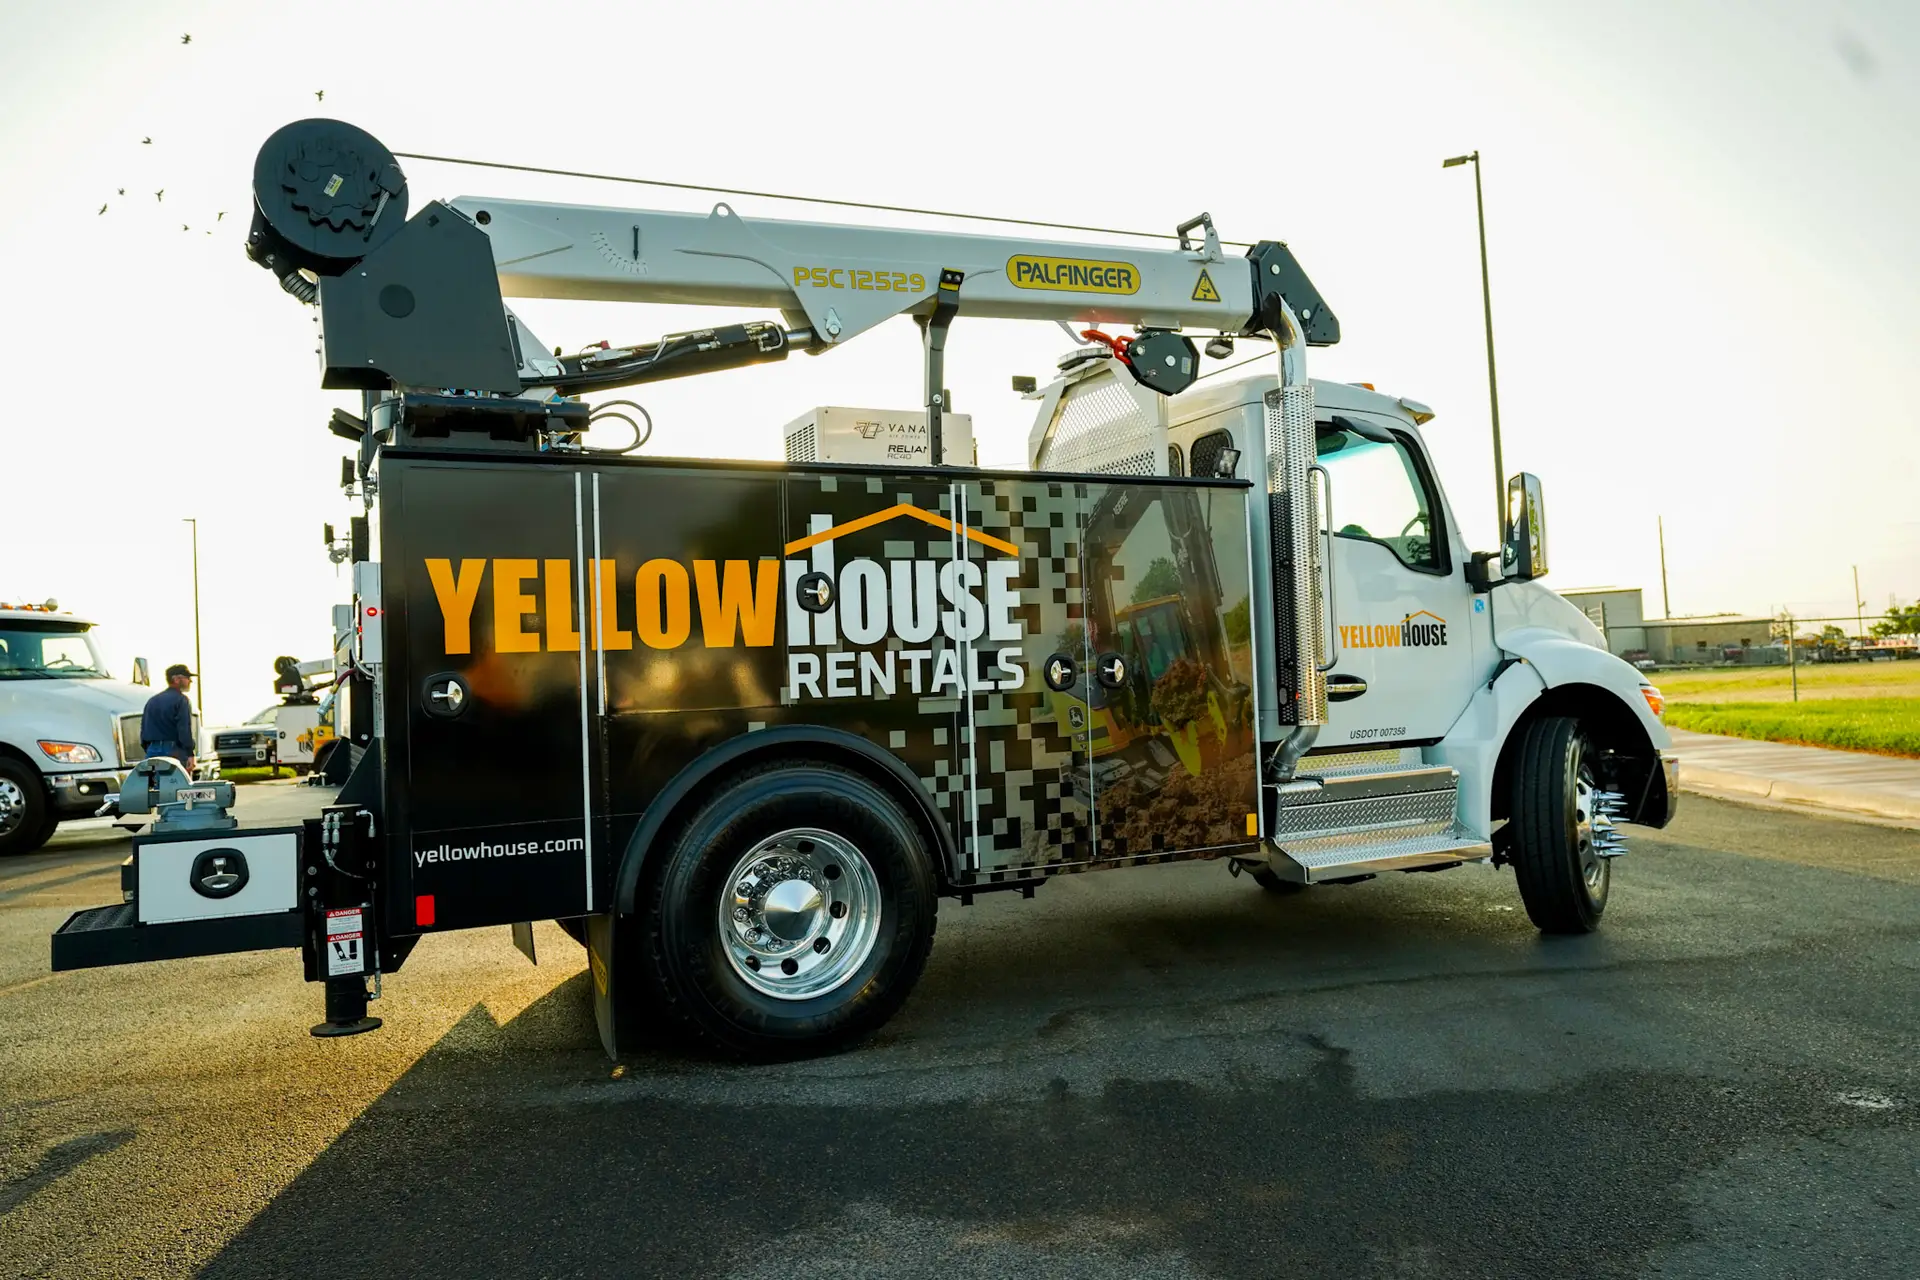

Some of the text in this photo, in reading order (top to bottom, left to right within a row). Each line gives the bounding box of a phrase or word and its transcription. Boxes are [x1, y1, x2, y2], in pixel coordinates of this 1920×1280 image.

[793, 266, 926, 293] PSC 12529
[1016, 261, 1133, 289] PALFINGER
[888, 423, 926, 434] VANA
[888, 444, 927, 454] RELIA
[788, 646, 1025, 700] RENTALS
[1350, 726, 1406, 739] USDOT 007358
[414, 838, 584, 868] yellowhouse.com
[335, 909, 360, 917] DANGER
[335, 932, 361, 940] DANGER
